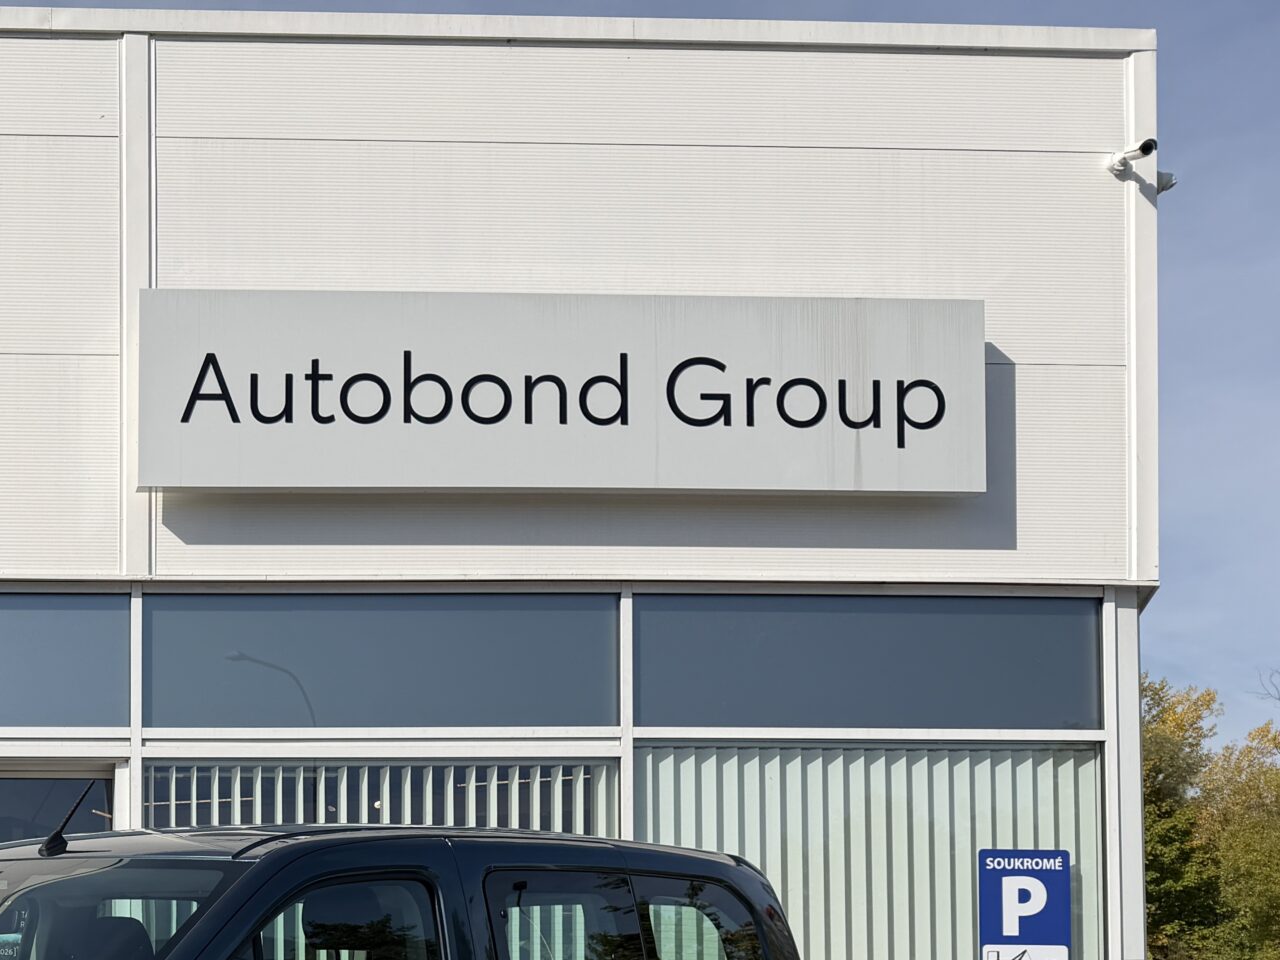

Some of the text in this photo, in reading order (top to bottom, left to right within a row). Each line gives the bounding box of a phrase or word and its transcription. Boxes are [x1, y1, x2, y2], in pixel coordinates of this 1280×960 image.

[180, 350, 946, 449] Autobond Group
[985, 856, 1063, 871] SOUKROMÉ
[1002, 875, 1048, 937] P
